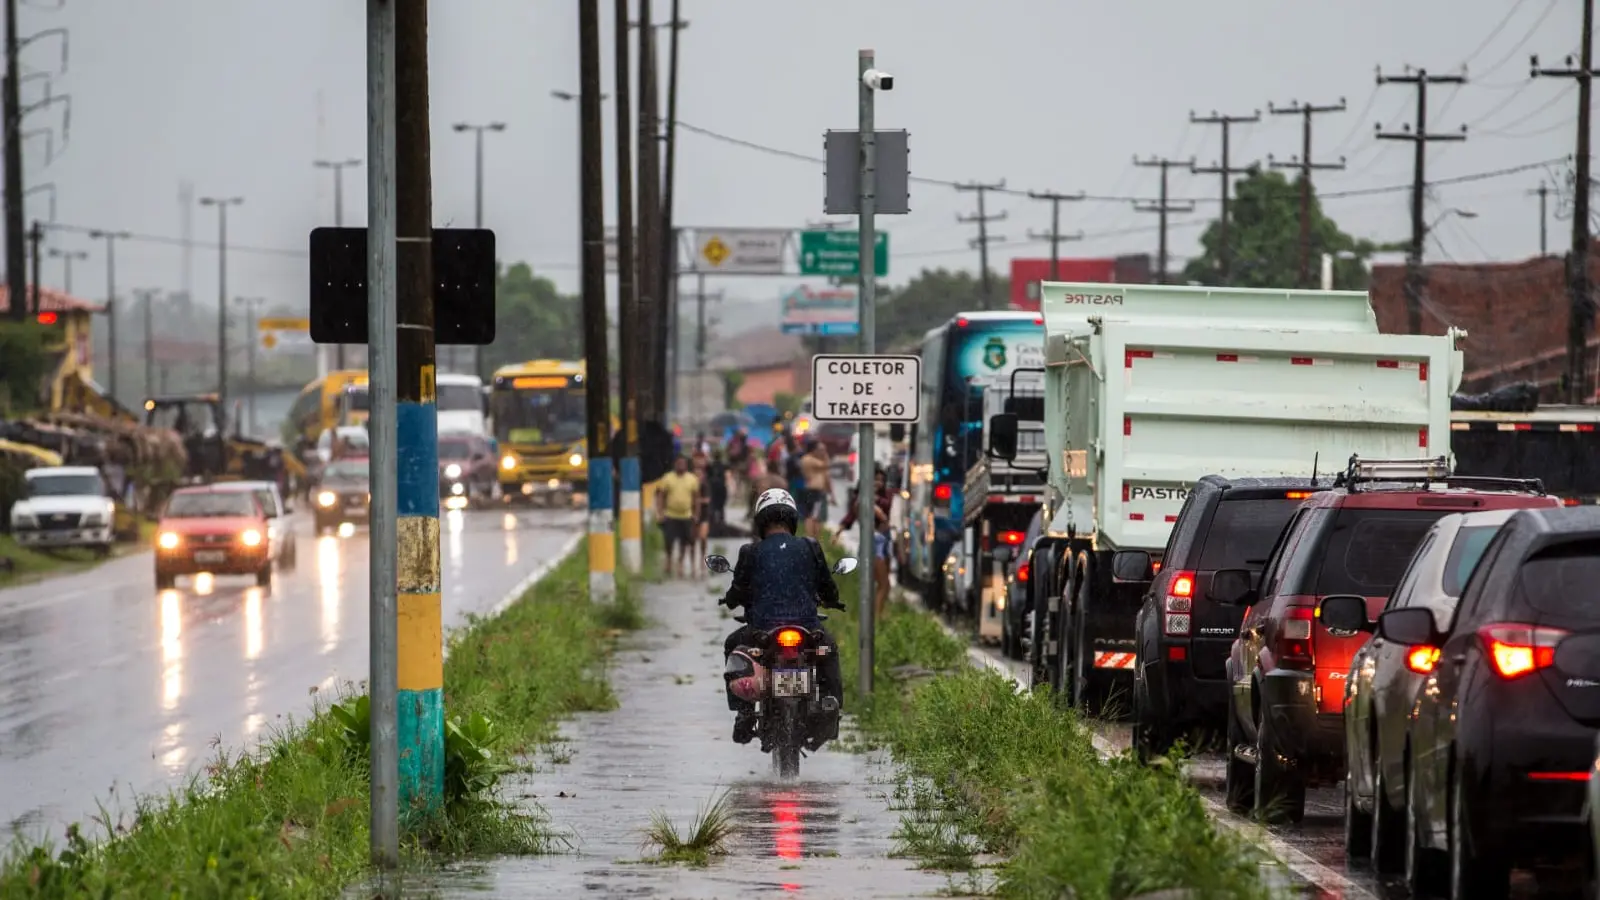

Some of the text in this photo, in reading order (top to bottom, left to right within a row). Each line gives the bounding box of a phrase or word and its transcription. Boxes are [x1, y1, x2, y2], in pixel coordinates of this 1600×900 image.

[828, 361, 905, 375] COLETOR
[853, 382, 874, 395] DE
[828, 400, 905, 416] TRÁFEGO
